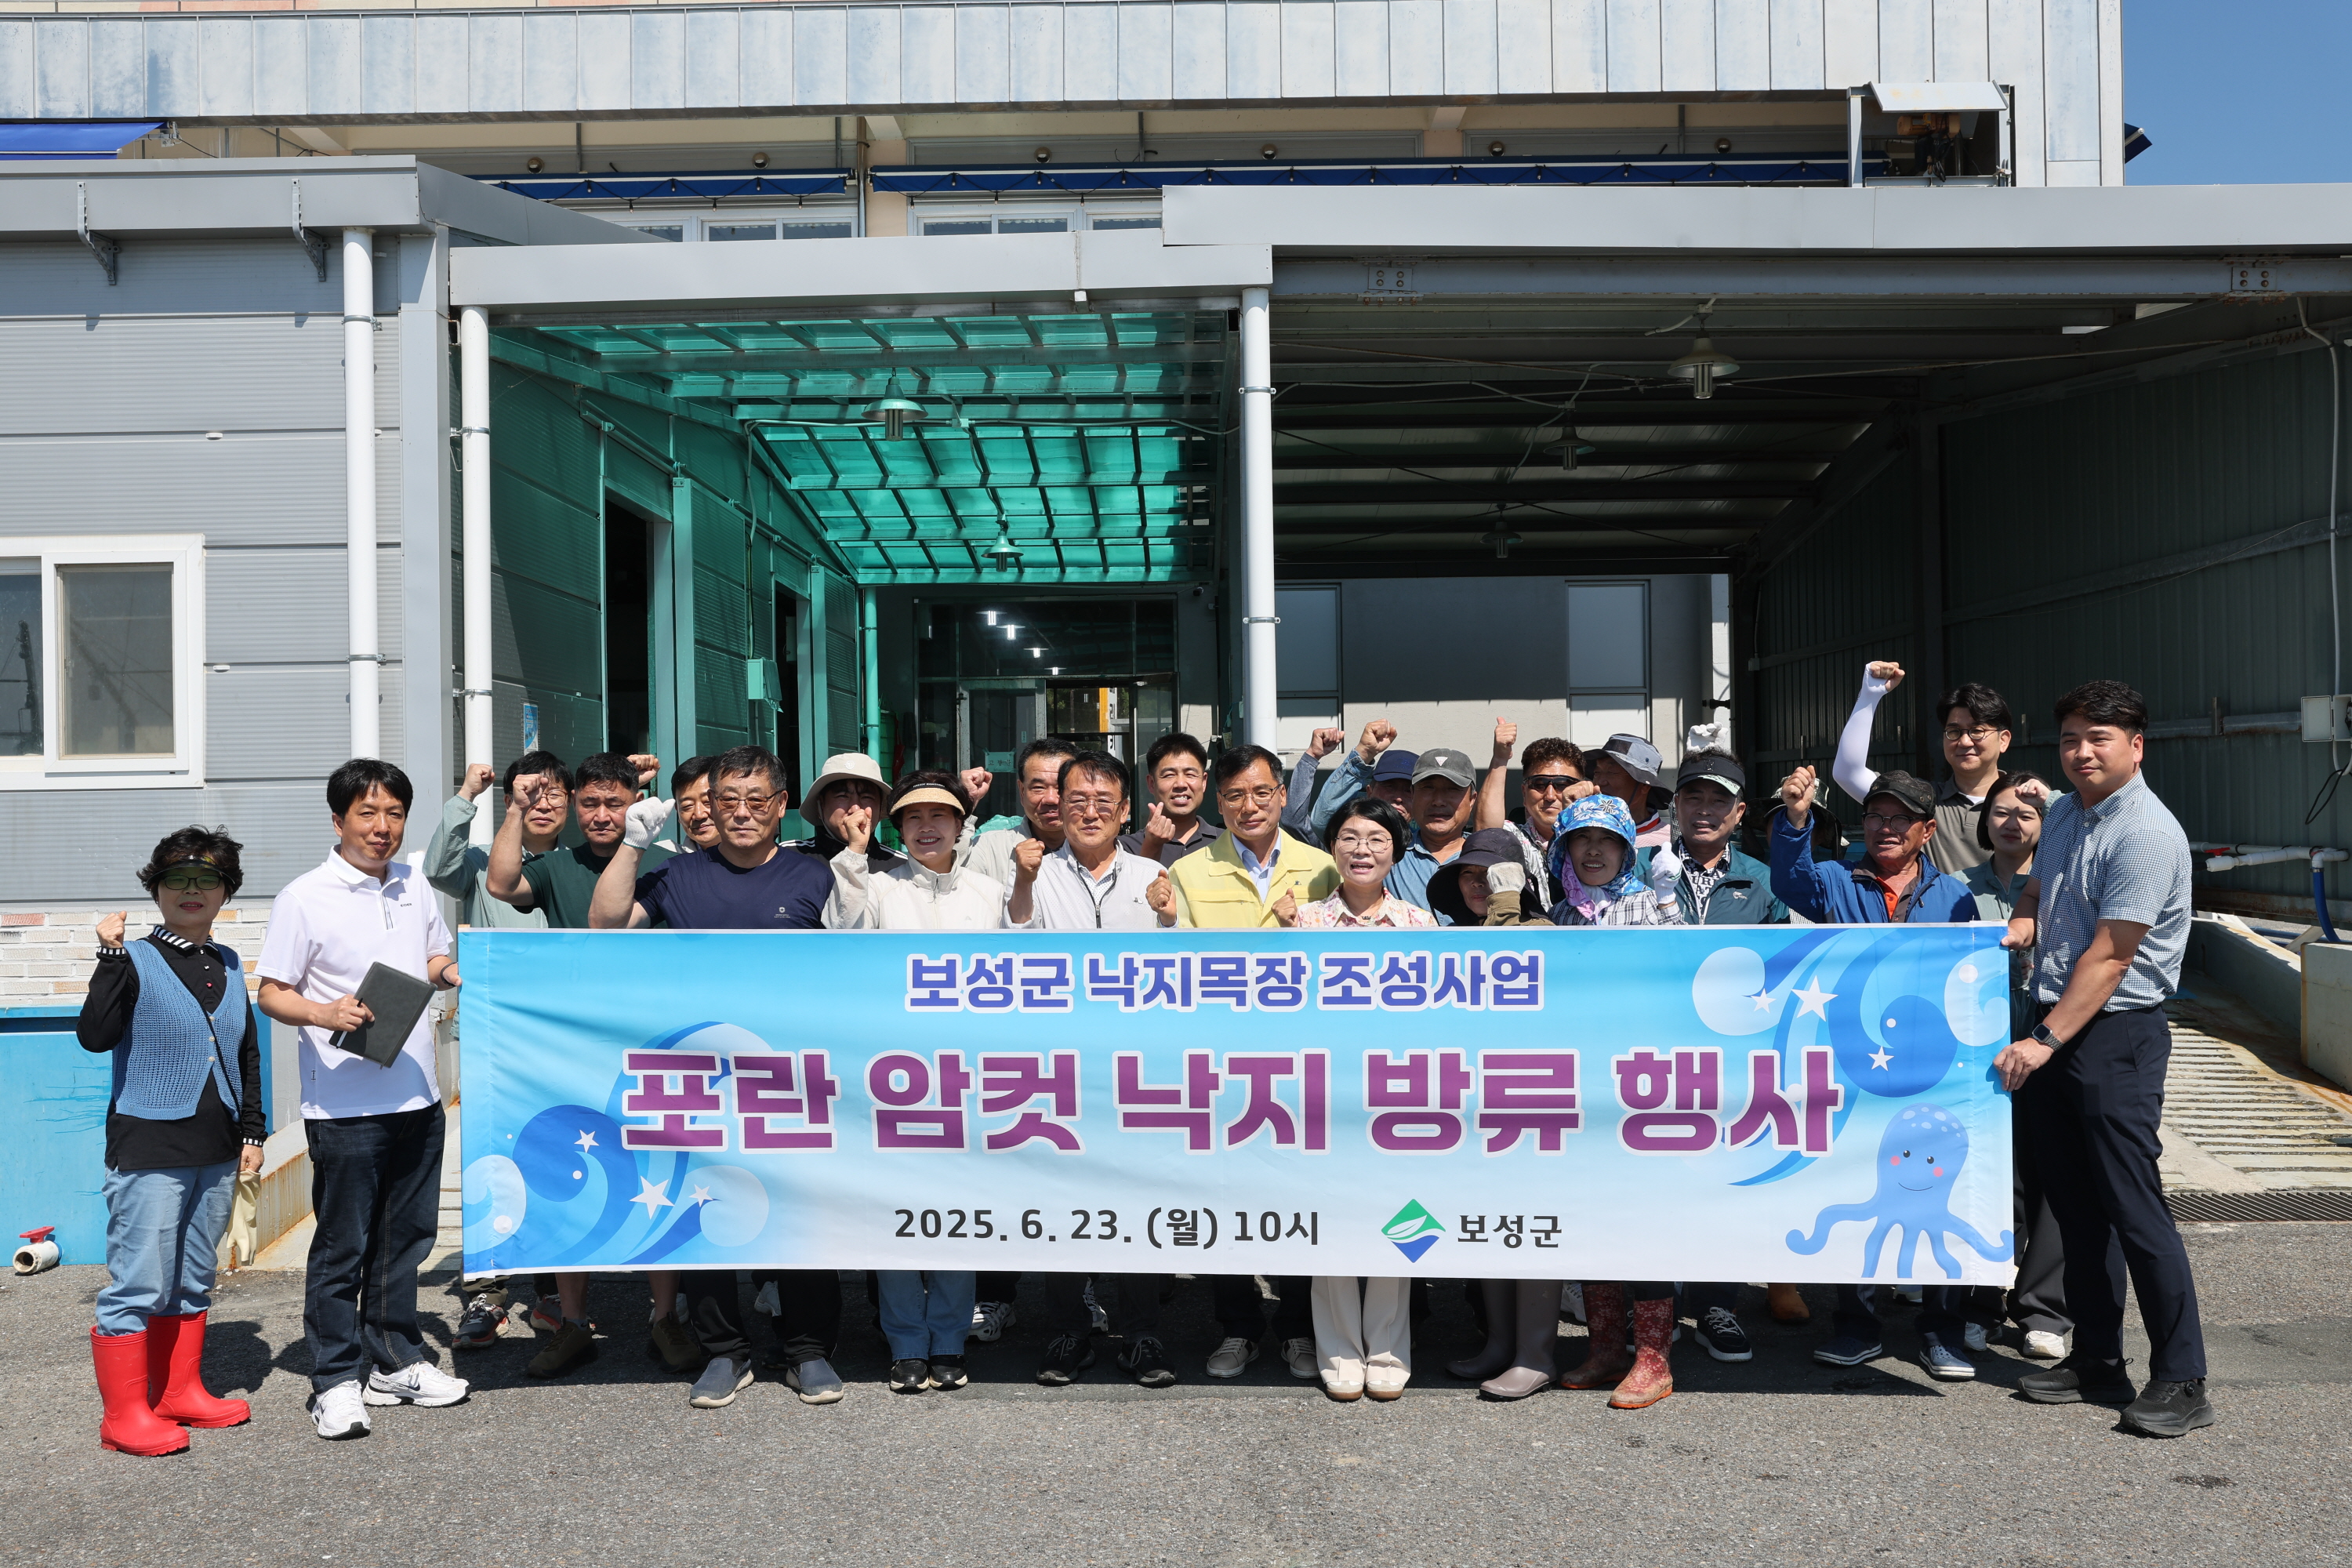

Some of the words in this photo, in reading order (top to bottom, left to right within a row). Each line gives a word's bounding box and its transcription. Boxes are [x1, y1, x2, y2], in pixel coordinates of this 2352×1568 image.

[910, 957, 1069, 1008] 보성군
[1089, 956, 1307, 1008] 낙지목장
[1322, 955, 1539, 1007] 조성사업
[625, 1052, 837, 1150] 포란
[869, 1053, 1081, 1151] 암컷
[1117, 1053, 1327, 1151] 낙지
[1367, 1052, 1580, 1152] 방류
[1615, 1051, 1838, 1152] 행사
[895, 1209, 1007, 1242] 2025.
[1021, 1209, 1056, 1242] 6.
[1070, 1209, 1131, 1243] 23.
[1147, 1207, 1218, 1250] (월)
[1234, 1210, 1318, 1246] 10시
[1457, 1214, 1563, 1250] 보성군
